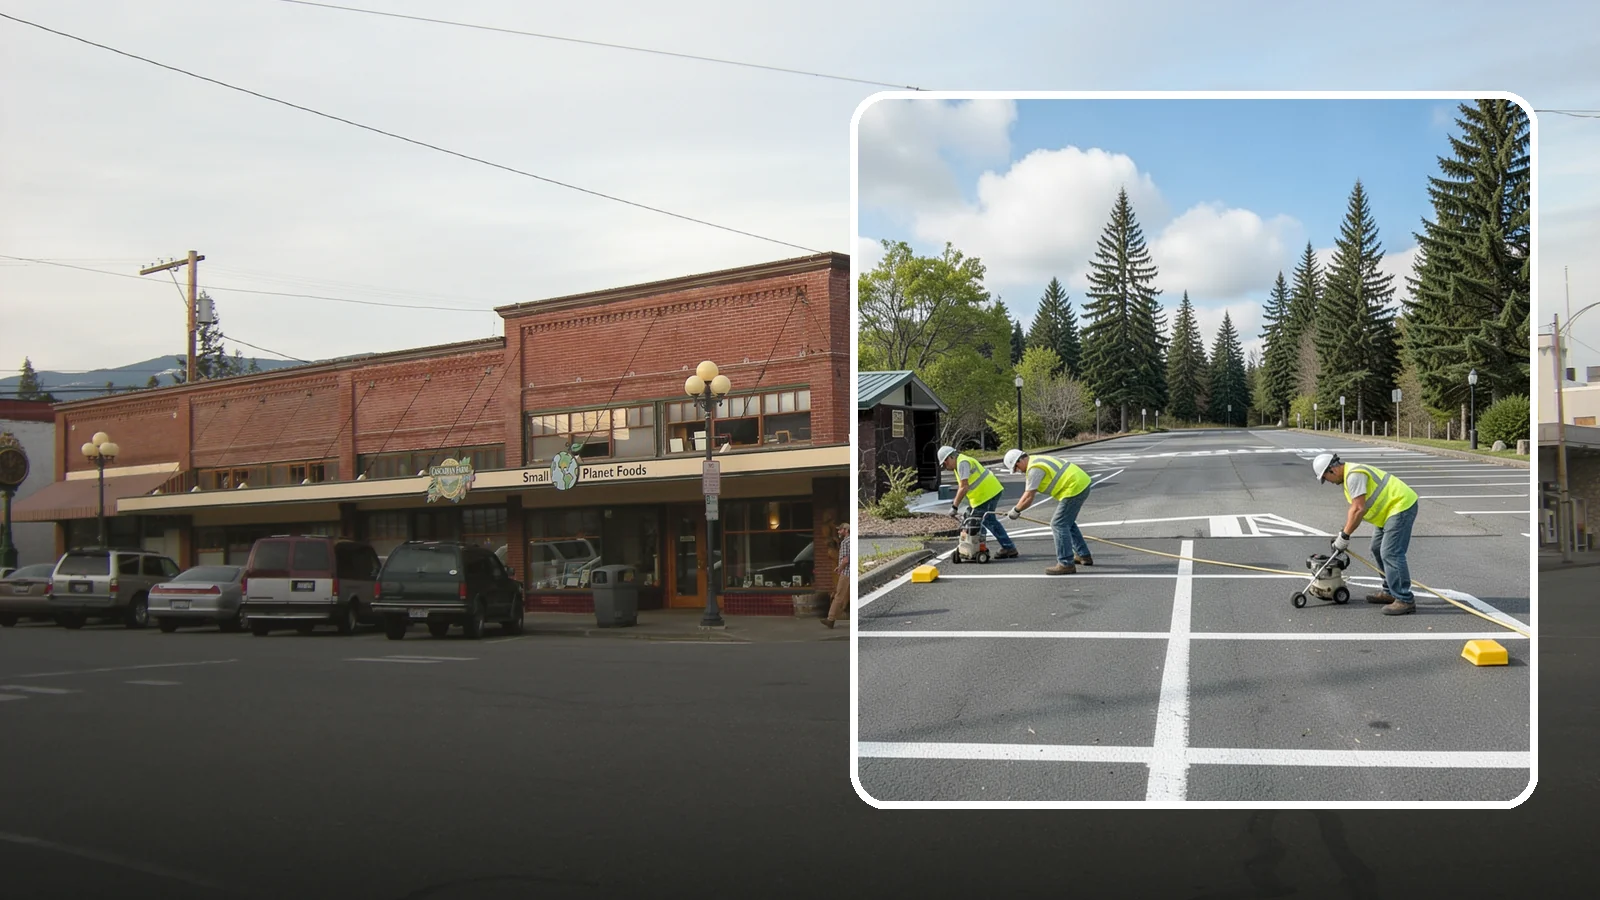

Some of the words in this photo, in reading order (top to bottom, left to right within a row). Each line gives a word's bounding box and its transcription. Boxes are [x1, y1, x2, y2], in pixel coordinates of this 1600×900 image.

[523, 471, 549, 483] Small
[583, 467, 614, 480] Planet
[617, 464, 647, 477] Foods
